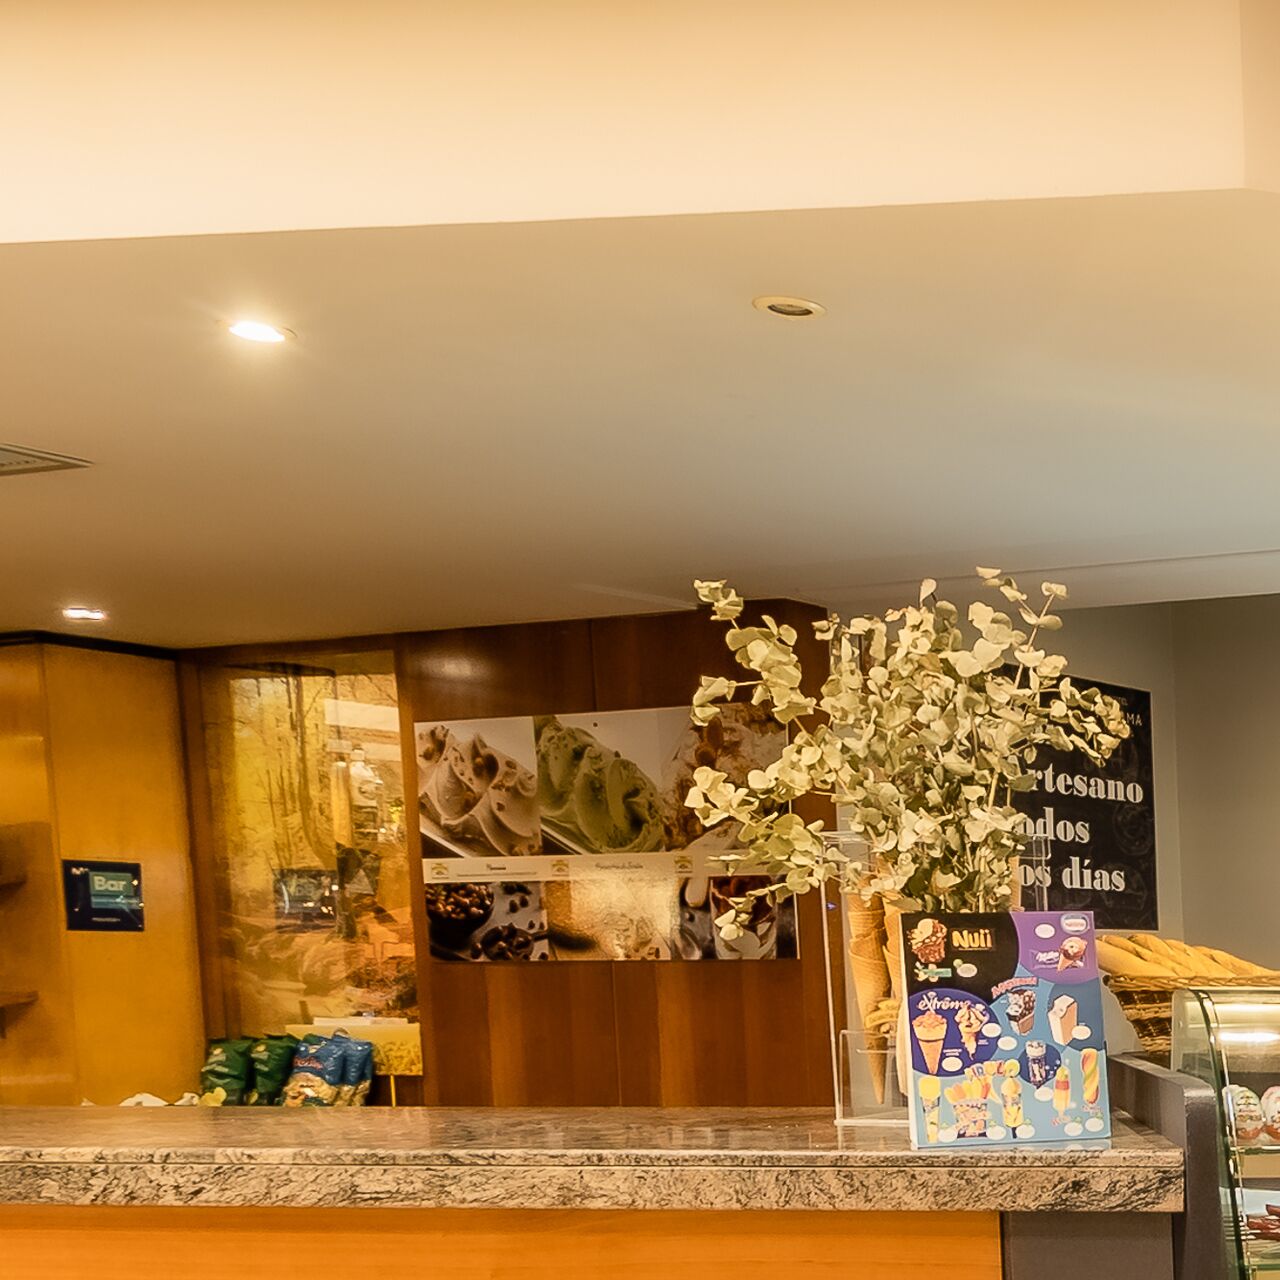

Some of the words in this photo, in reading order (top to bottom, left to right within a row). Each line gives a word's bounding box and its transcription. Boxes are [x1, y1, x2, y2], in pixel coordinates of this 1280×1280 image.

[1025, 762, 1144, 804] rtesano
[1015, 806, 1091, 844] odos
[93, 875, 127, 892] Bar
[1018, 864, 1052, 888] os
[1061, 855, 1126, 892] días
